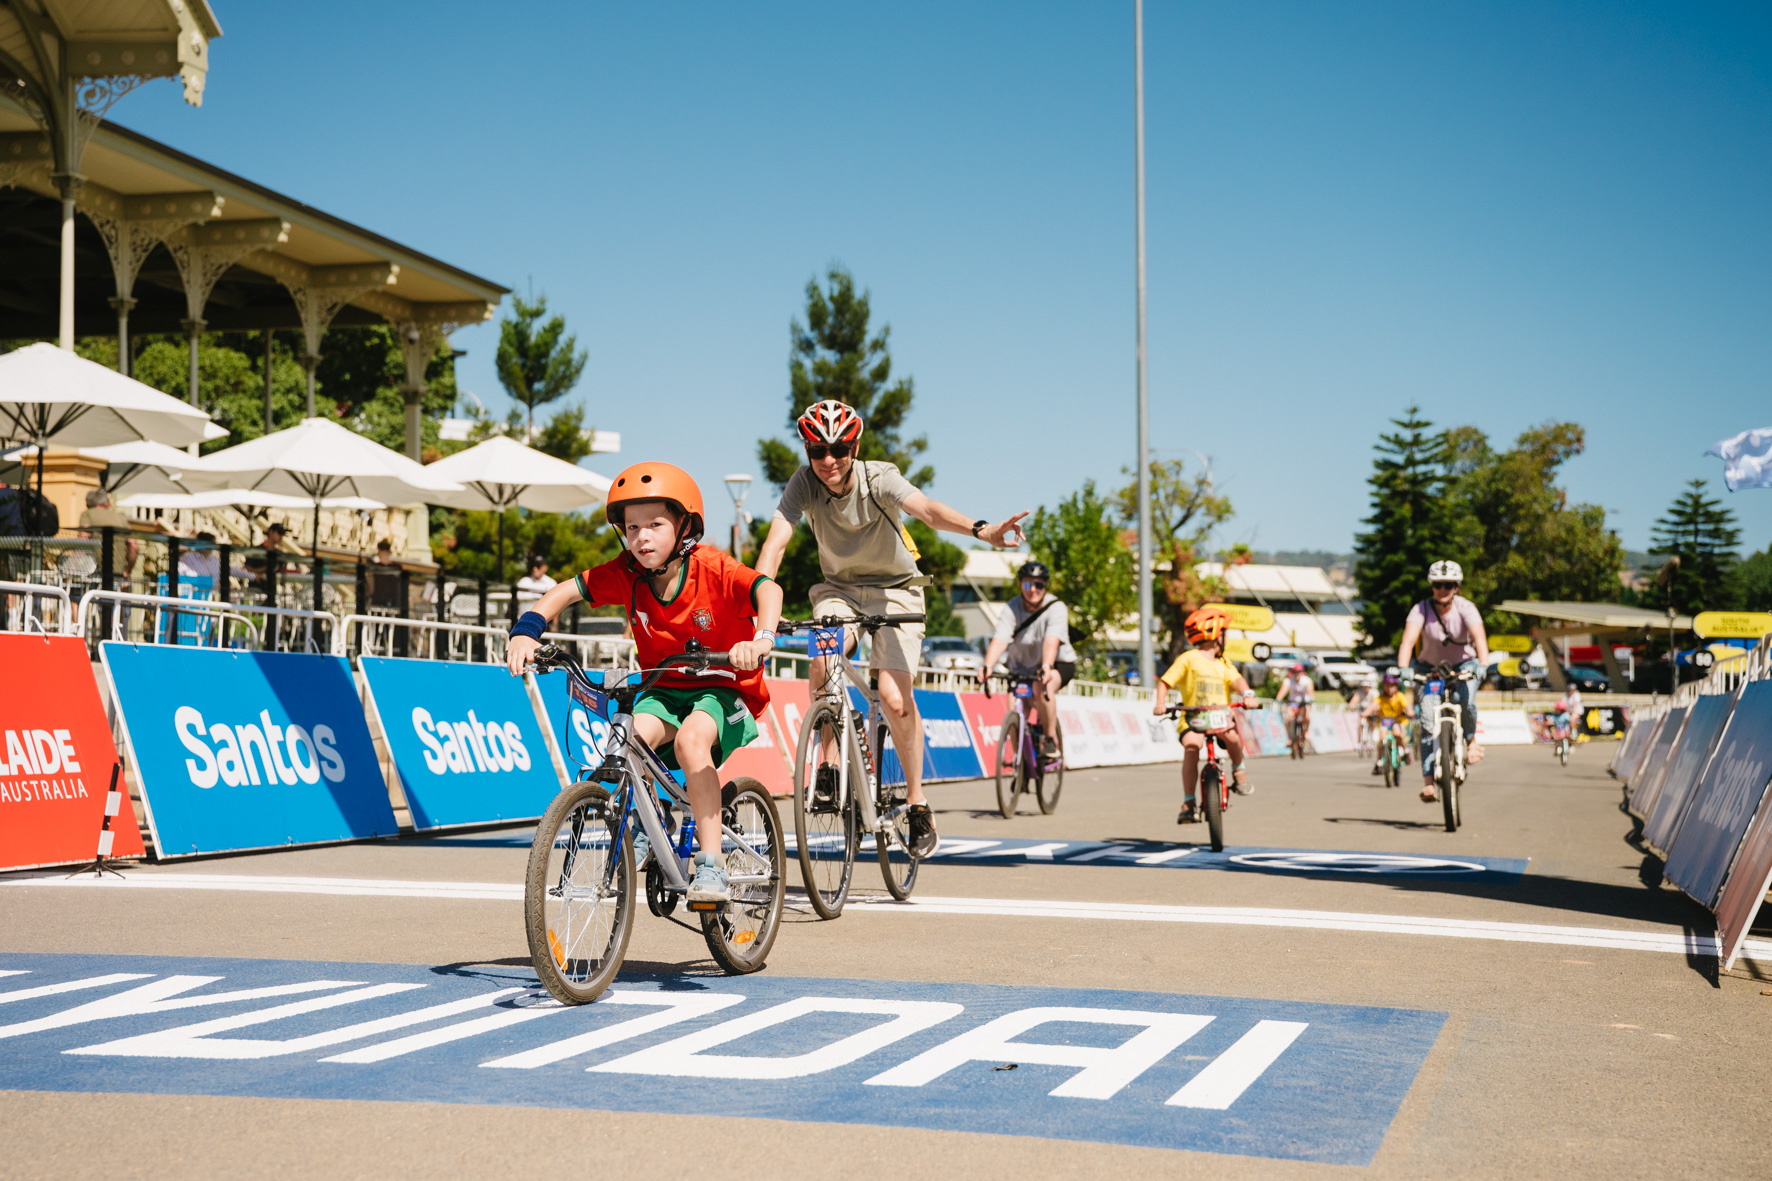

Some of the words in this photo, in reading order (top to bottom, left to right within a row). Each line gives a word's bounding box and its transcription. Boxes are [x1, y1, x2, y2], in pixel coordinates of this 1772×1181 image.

[174, 705, 346, 789] Santos
[411, 706, 532, 775] Santos
[0, 778, 89, 803] AUSTRALIA
[1698, 740, 1763, 833] Santos
